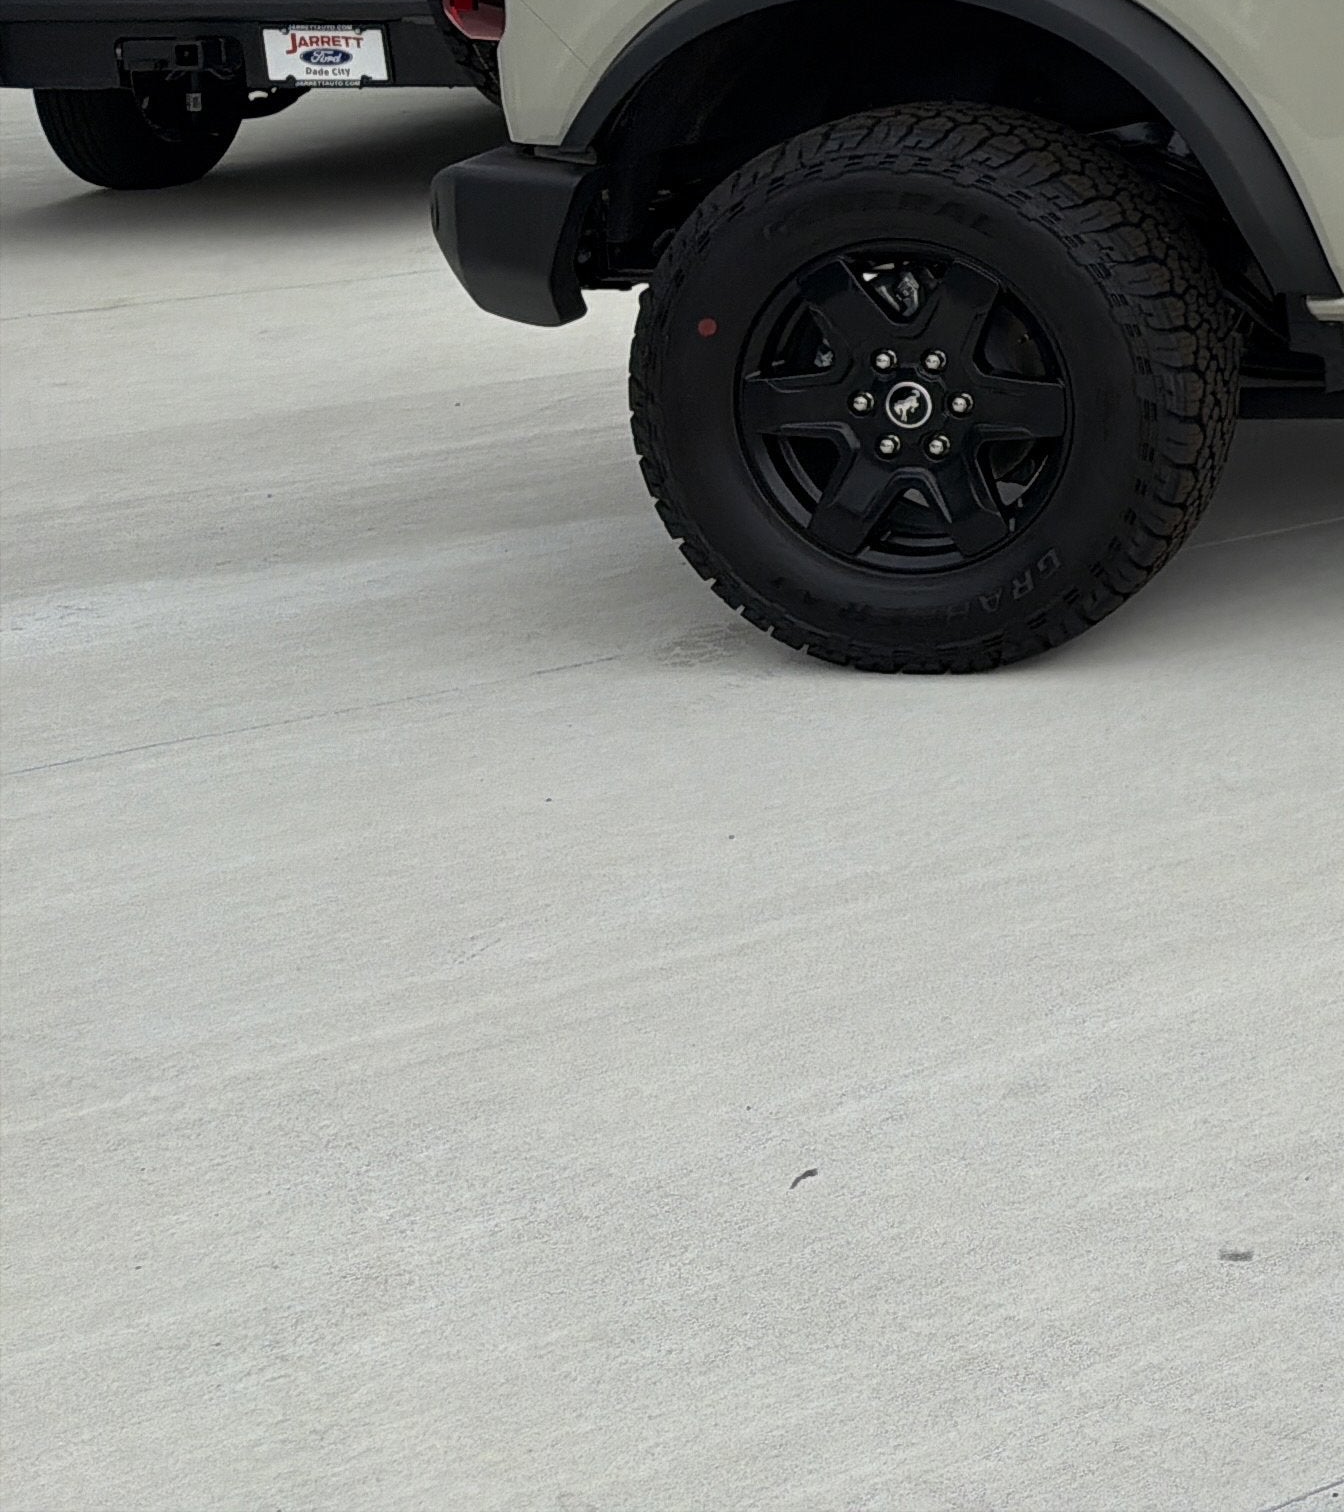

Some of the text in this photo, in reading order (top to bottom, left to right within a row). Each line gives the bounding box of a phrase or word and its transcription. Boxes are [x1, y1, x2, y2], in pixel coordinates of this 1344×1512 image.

[285, 33, 364, 55] JARRETT
[310, 50, 343, 63] Ford
[305, 67, 351, 76] Dade City
